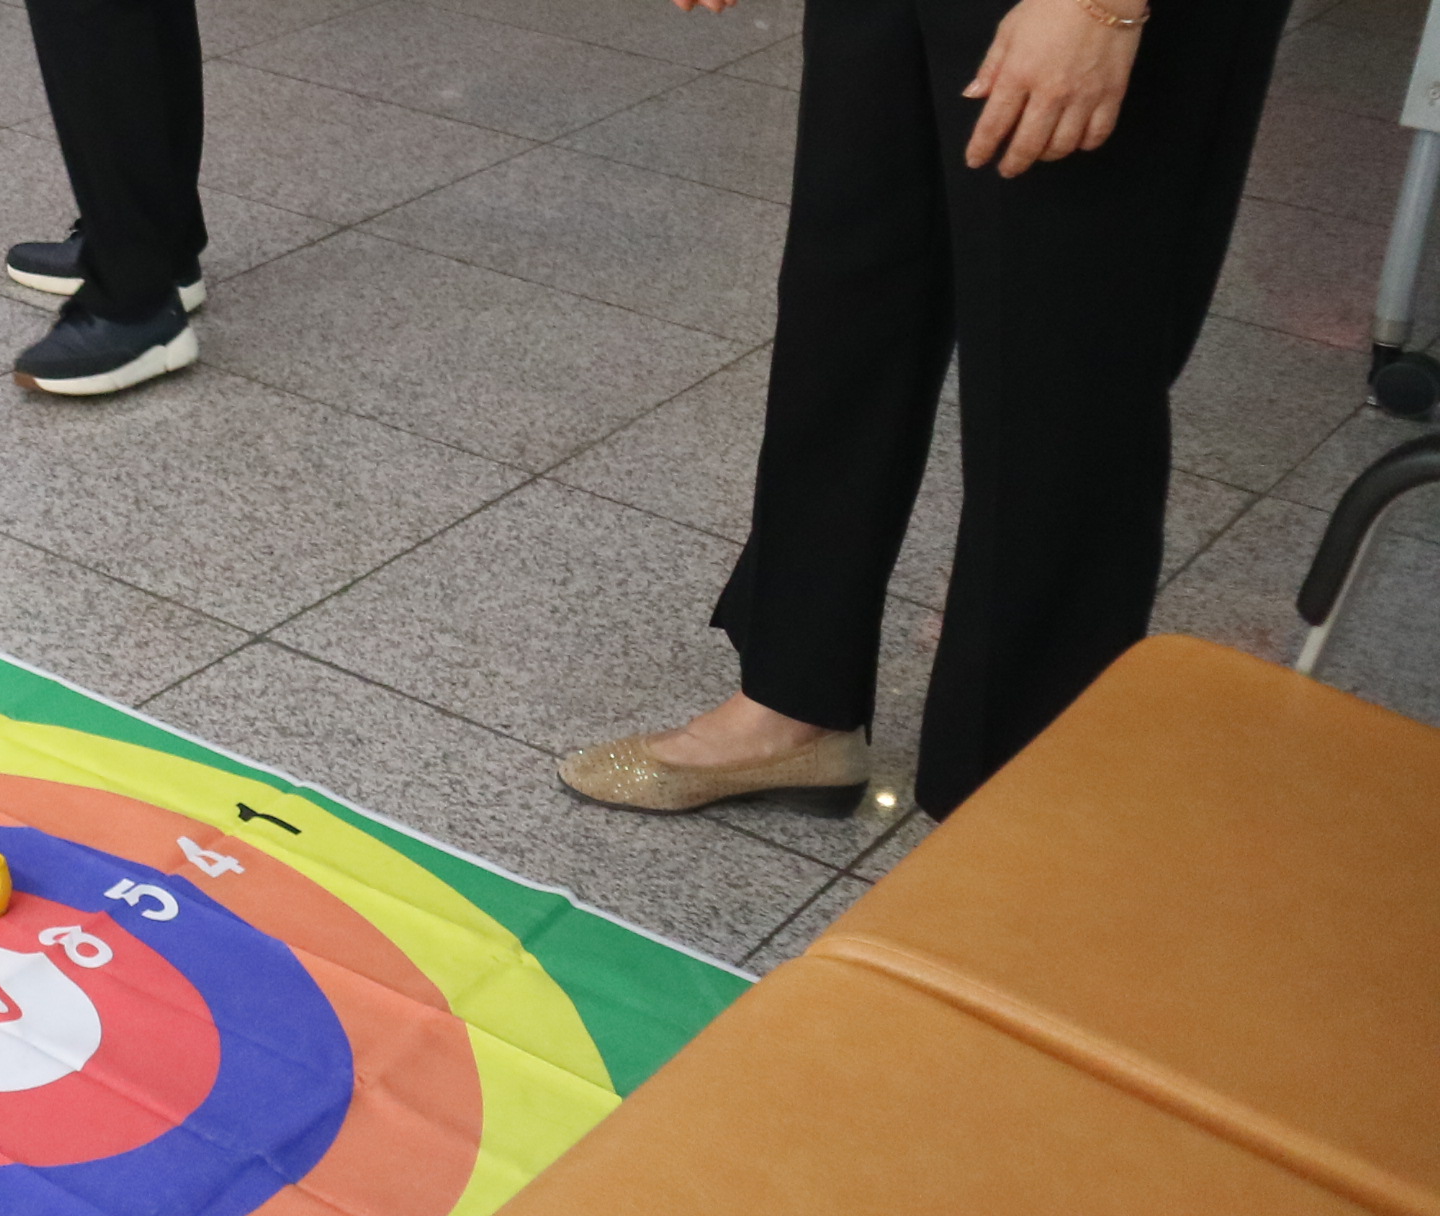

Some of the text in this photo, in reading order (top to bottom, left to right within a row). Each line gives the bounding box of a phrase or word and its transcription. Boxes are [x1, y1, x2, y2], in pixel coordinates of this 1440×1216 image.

[236, 802, 302, 835] 1
[176, 835, 246, 878] 4
[103, 877, 180, 922] 5
